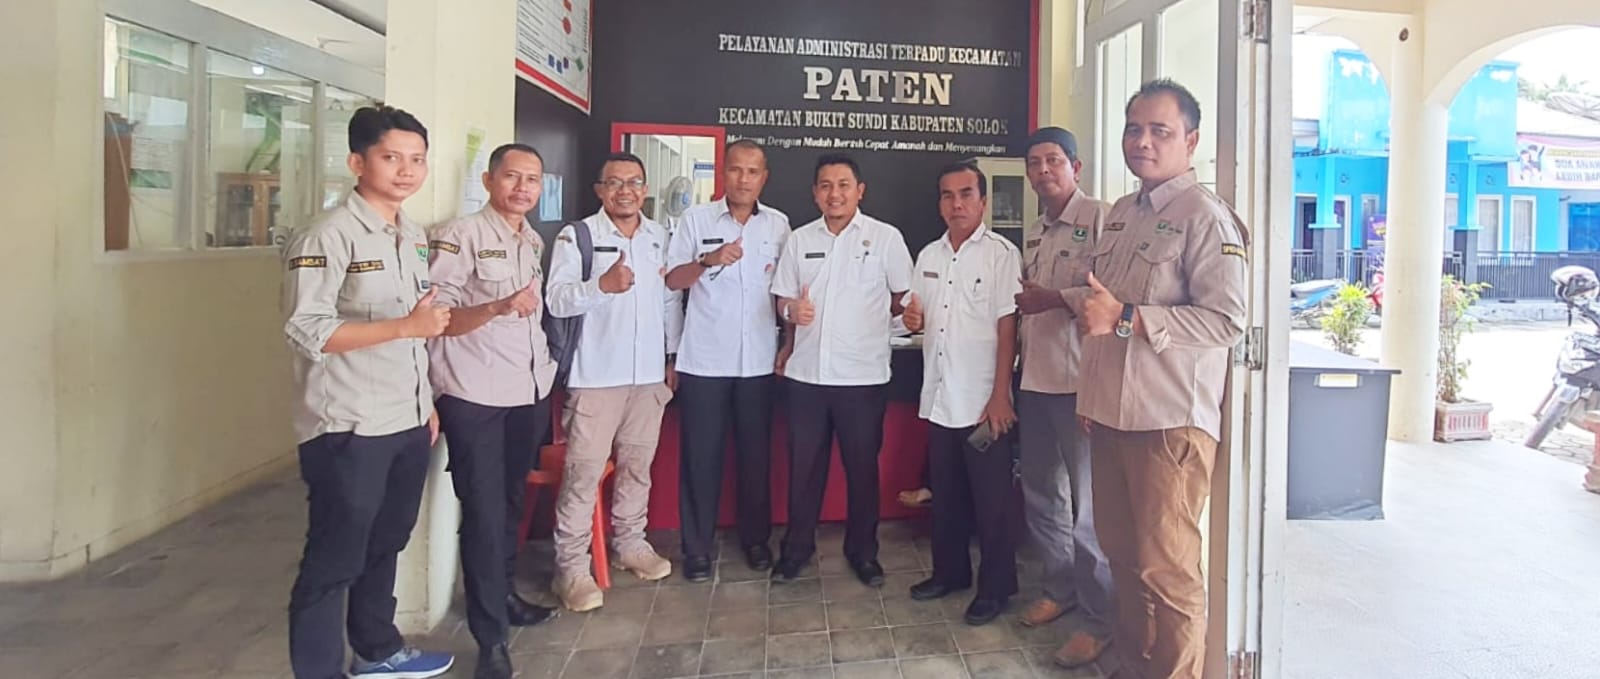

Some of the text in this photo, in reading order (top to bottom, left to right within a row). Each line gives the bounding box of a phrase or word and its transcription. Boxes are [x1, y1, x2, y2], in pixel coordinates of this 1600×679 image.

[719, 34, 1021, 66] PELAYANAN ADMINISTRASI TERPADU KECAMATAN
[803, 66, 953, 105] PATEN
[719, 108, 1008, 135] KECAMATAN BUKIT SUNDI KABUPATEN SOLOK
[767, 136, 801, 148] Dengan
[803, 137, 832, 147] Mudah
[865, 140, 889, 151] Cepat
[891, 141, 925, 151] Amanah
[927, 142, 943, 151] dan
[945, 142, 1006, 154] Menyenangkan
